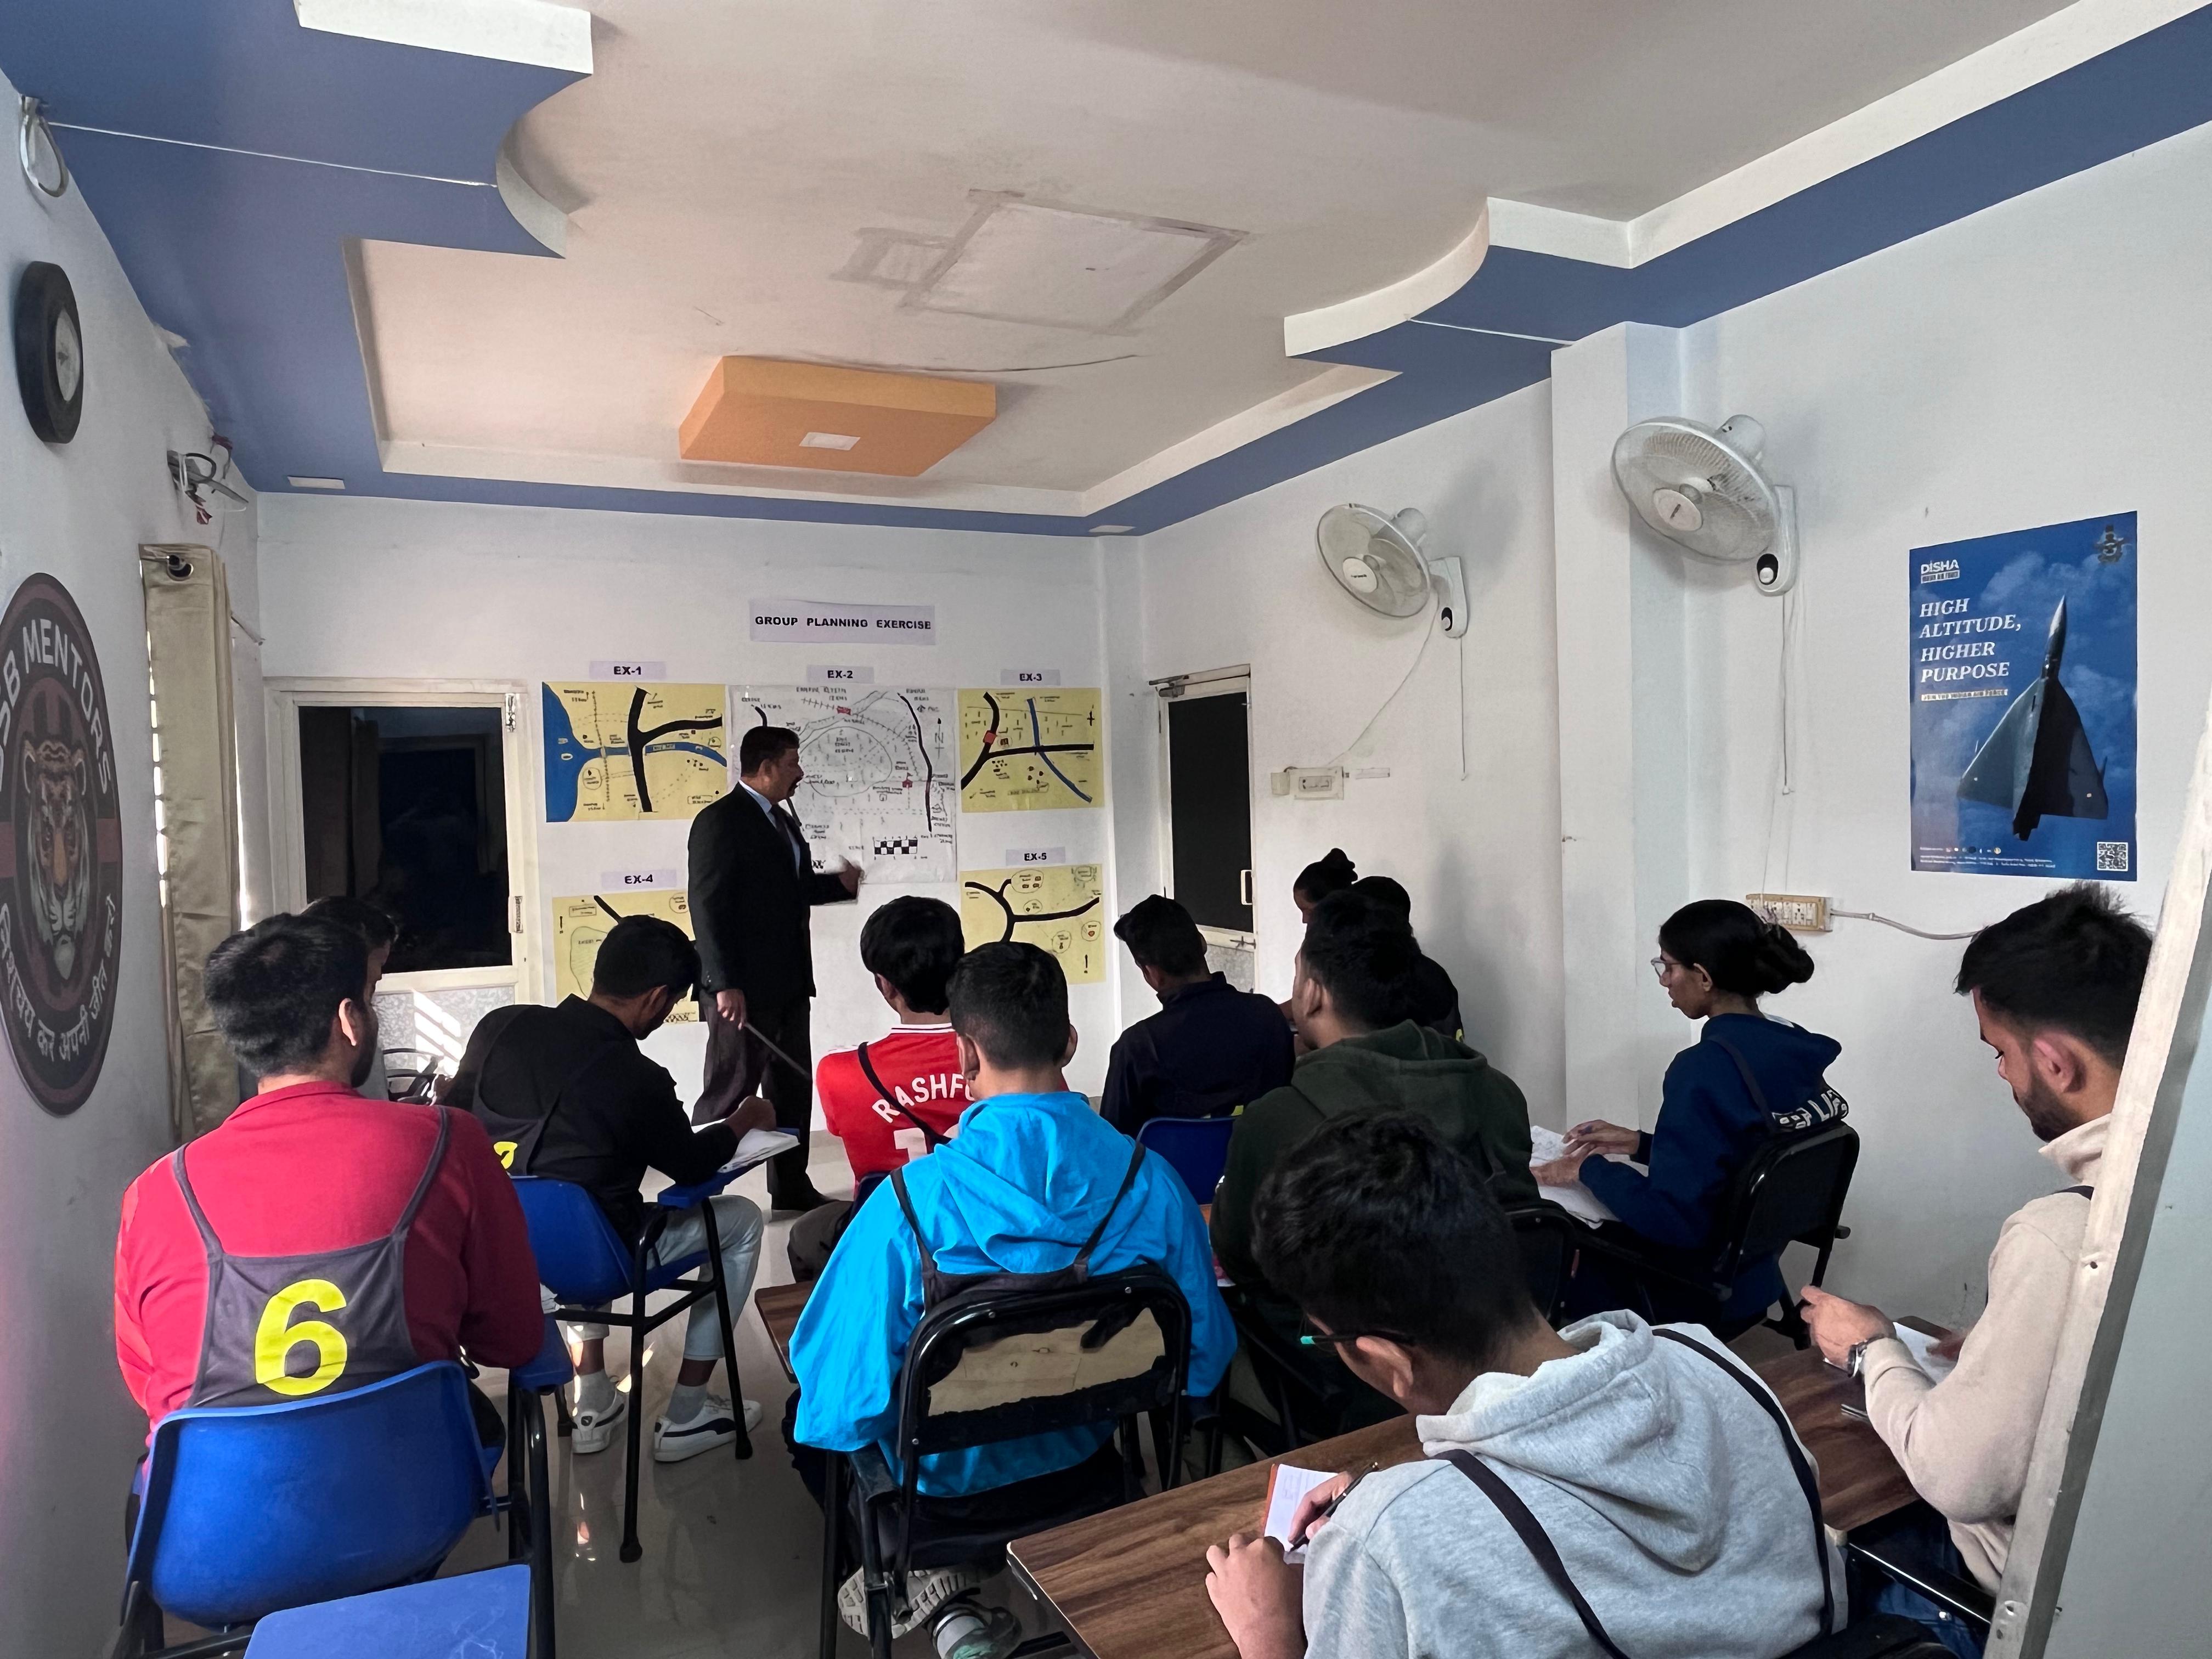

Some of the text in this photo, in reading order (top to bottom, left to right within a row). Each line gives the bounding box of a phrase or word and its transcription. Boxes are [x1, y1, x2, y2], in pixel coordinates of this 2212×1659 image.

[1921, 559, 1959, 574] DISHA
[1920, 597, 1970, 617] HIGH
[755, 616, 931, 629] GROUP PLANNING EXERCISE
[1919, 614, 2021, 638] ALTITUDE,
[1920, 641, 1995, 662] HIGHER
[613, 666, 641, 675] EX-1
[827, 670, 853, 679] EX-2
[1921, 662, 2010, 682] PURPOSE
[23, 618, 110, 794] MENTORS
[624, 874, 653, 884] EX-4
[255, 1279, 347, 1395] 6
